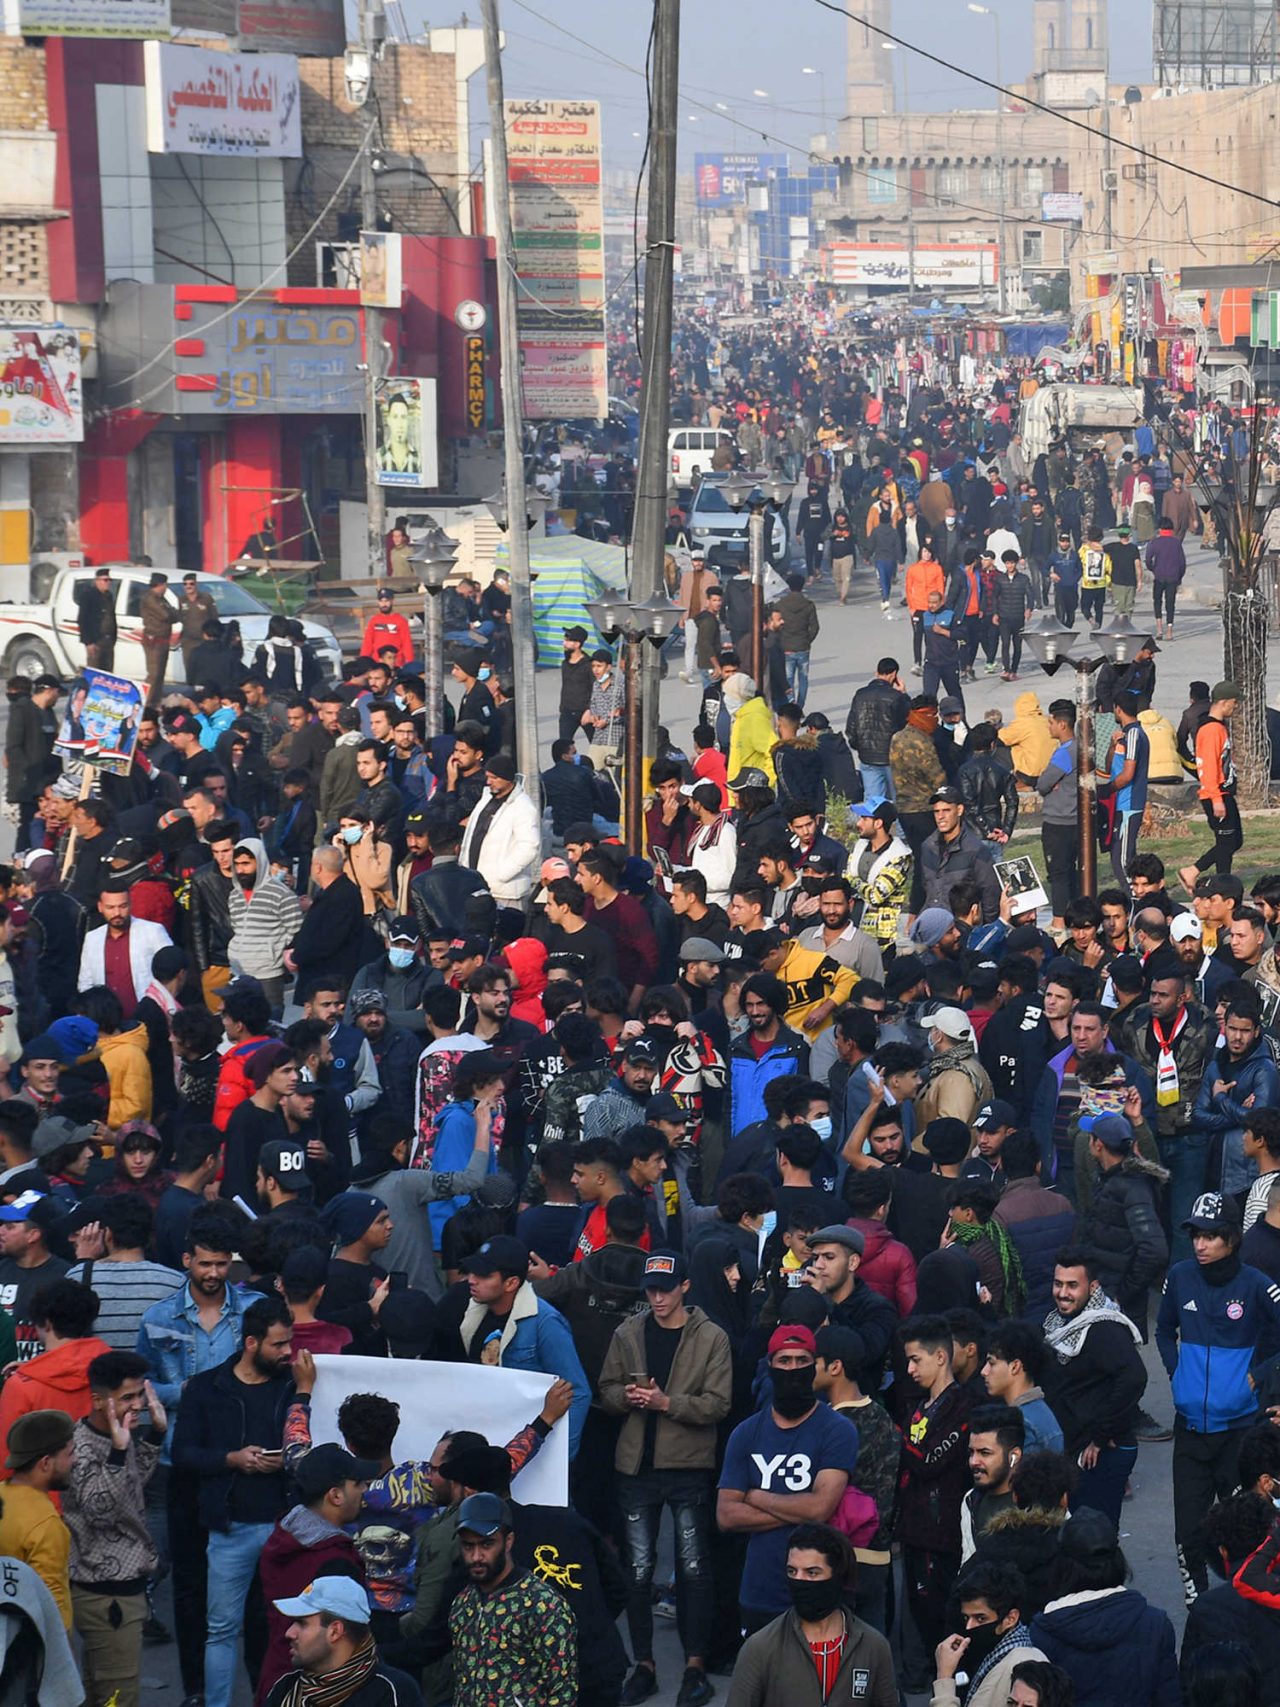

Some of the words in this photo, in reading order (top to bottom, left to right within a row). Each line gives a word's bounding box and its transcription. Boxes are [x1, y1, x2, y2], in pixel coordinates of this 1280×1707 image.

[231, 307, 357, 355] مختبر
[468, 338, 484, 428] PHARMCY
[279, 1151, 305, 1172] BO
[751, 1453, 812, 1491] Y-3
[3, 1563, 19, 1597] OFF
